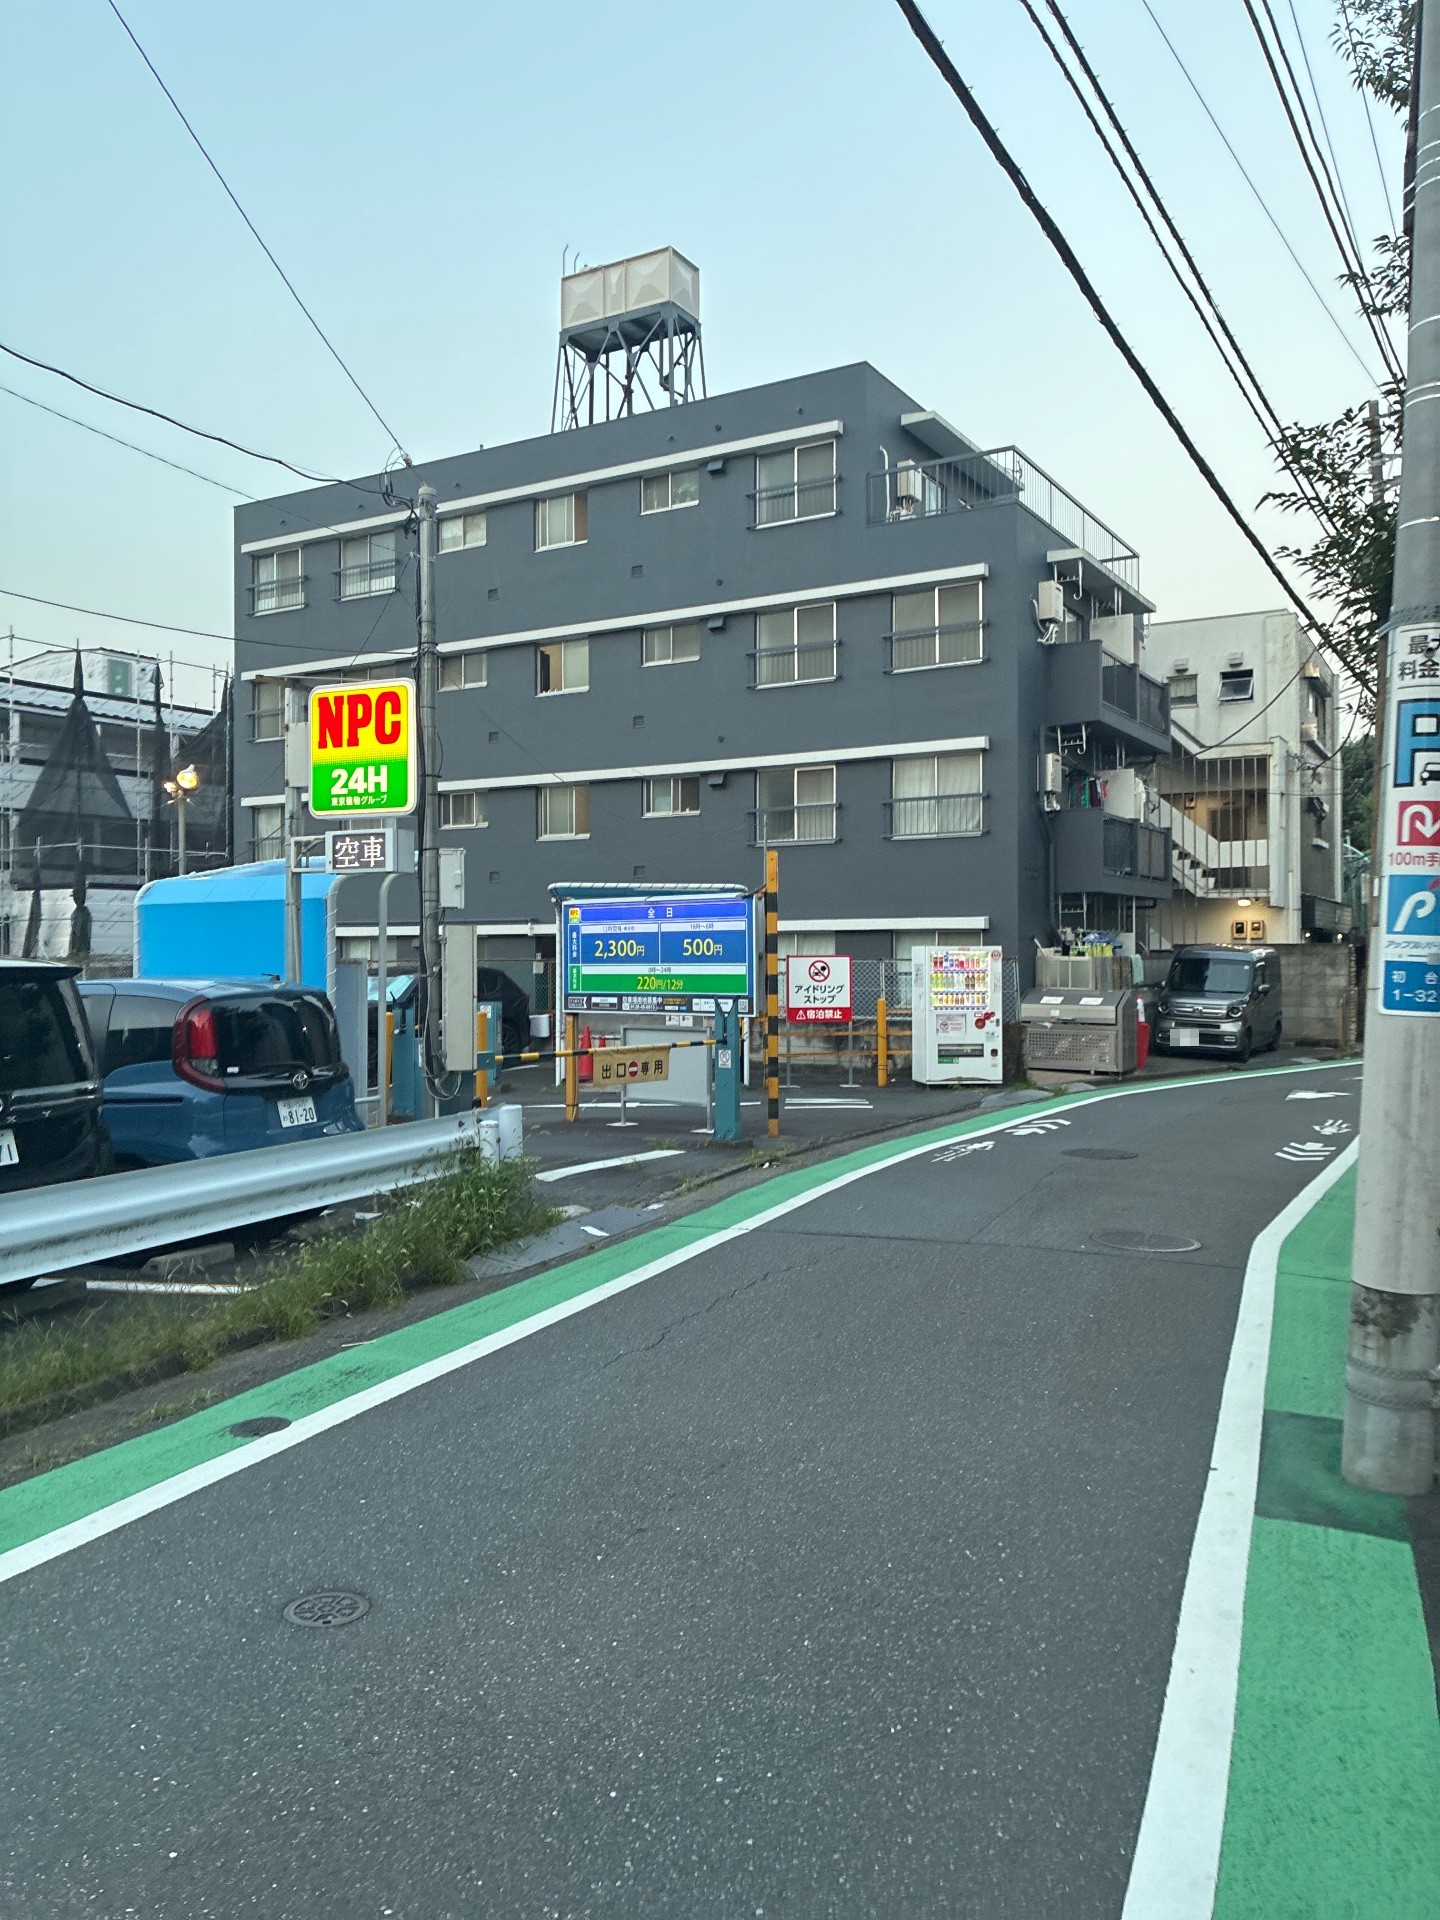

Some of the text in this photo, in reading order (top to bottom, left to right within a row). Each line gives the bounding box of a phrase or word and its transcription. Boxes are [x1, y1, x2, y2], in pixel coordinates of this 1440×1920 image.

[1398, 658, 1440, 681] 料金
[318, 691, 401, 750] NPC
[330, 765, 388, 795] 24H
[334, 835, 385, 868] 空車
[647, 907, 673, 919] 全日
[594, 939, 645, 960] 2,300円
[682, 938, 723, 956] 500円
[637, 975, 684, 990] 220円/12分
[794, 984, 845, 994] アイドリング
[803, 995, 836, 1004] ストップ
[1392, 989, 1438, 1003] 1-32
[806, 1009, 843, 1019] 宿泊禁止
[288, 1107, 315, 1125] 81-20
